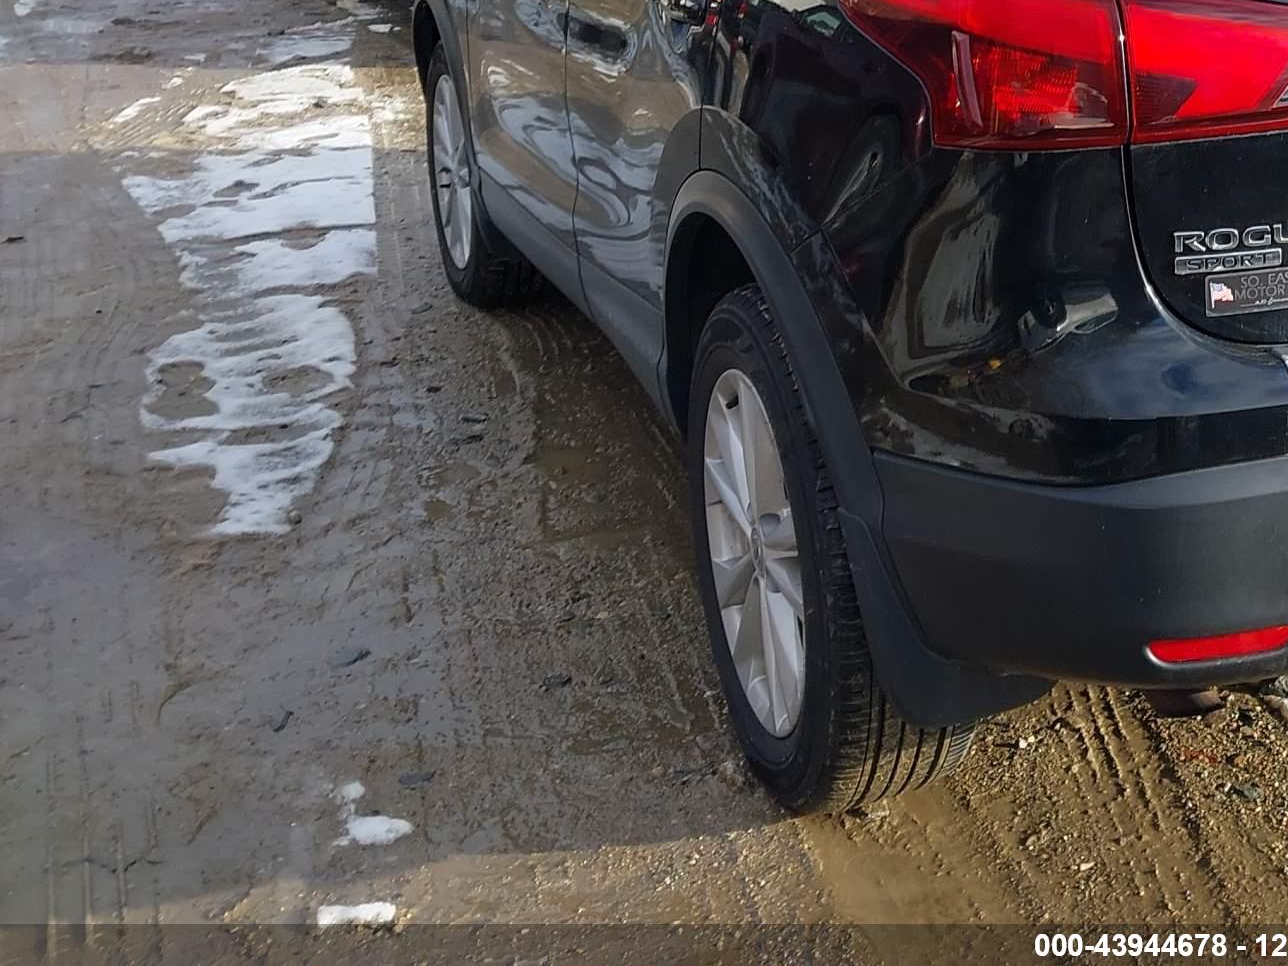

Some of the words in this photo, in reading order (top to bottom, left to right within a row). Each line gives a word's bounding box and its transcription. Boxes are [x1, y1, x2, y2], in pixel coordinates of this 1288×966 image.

[1185, 253, 1270, 271] SPORT
[1240, 275, 1264, 289] SO.
[1234, 283, 1286, 301] MOTOR
